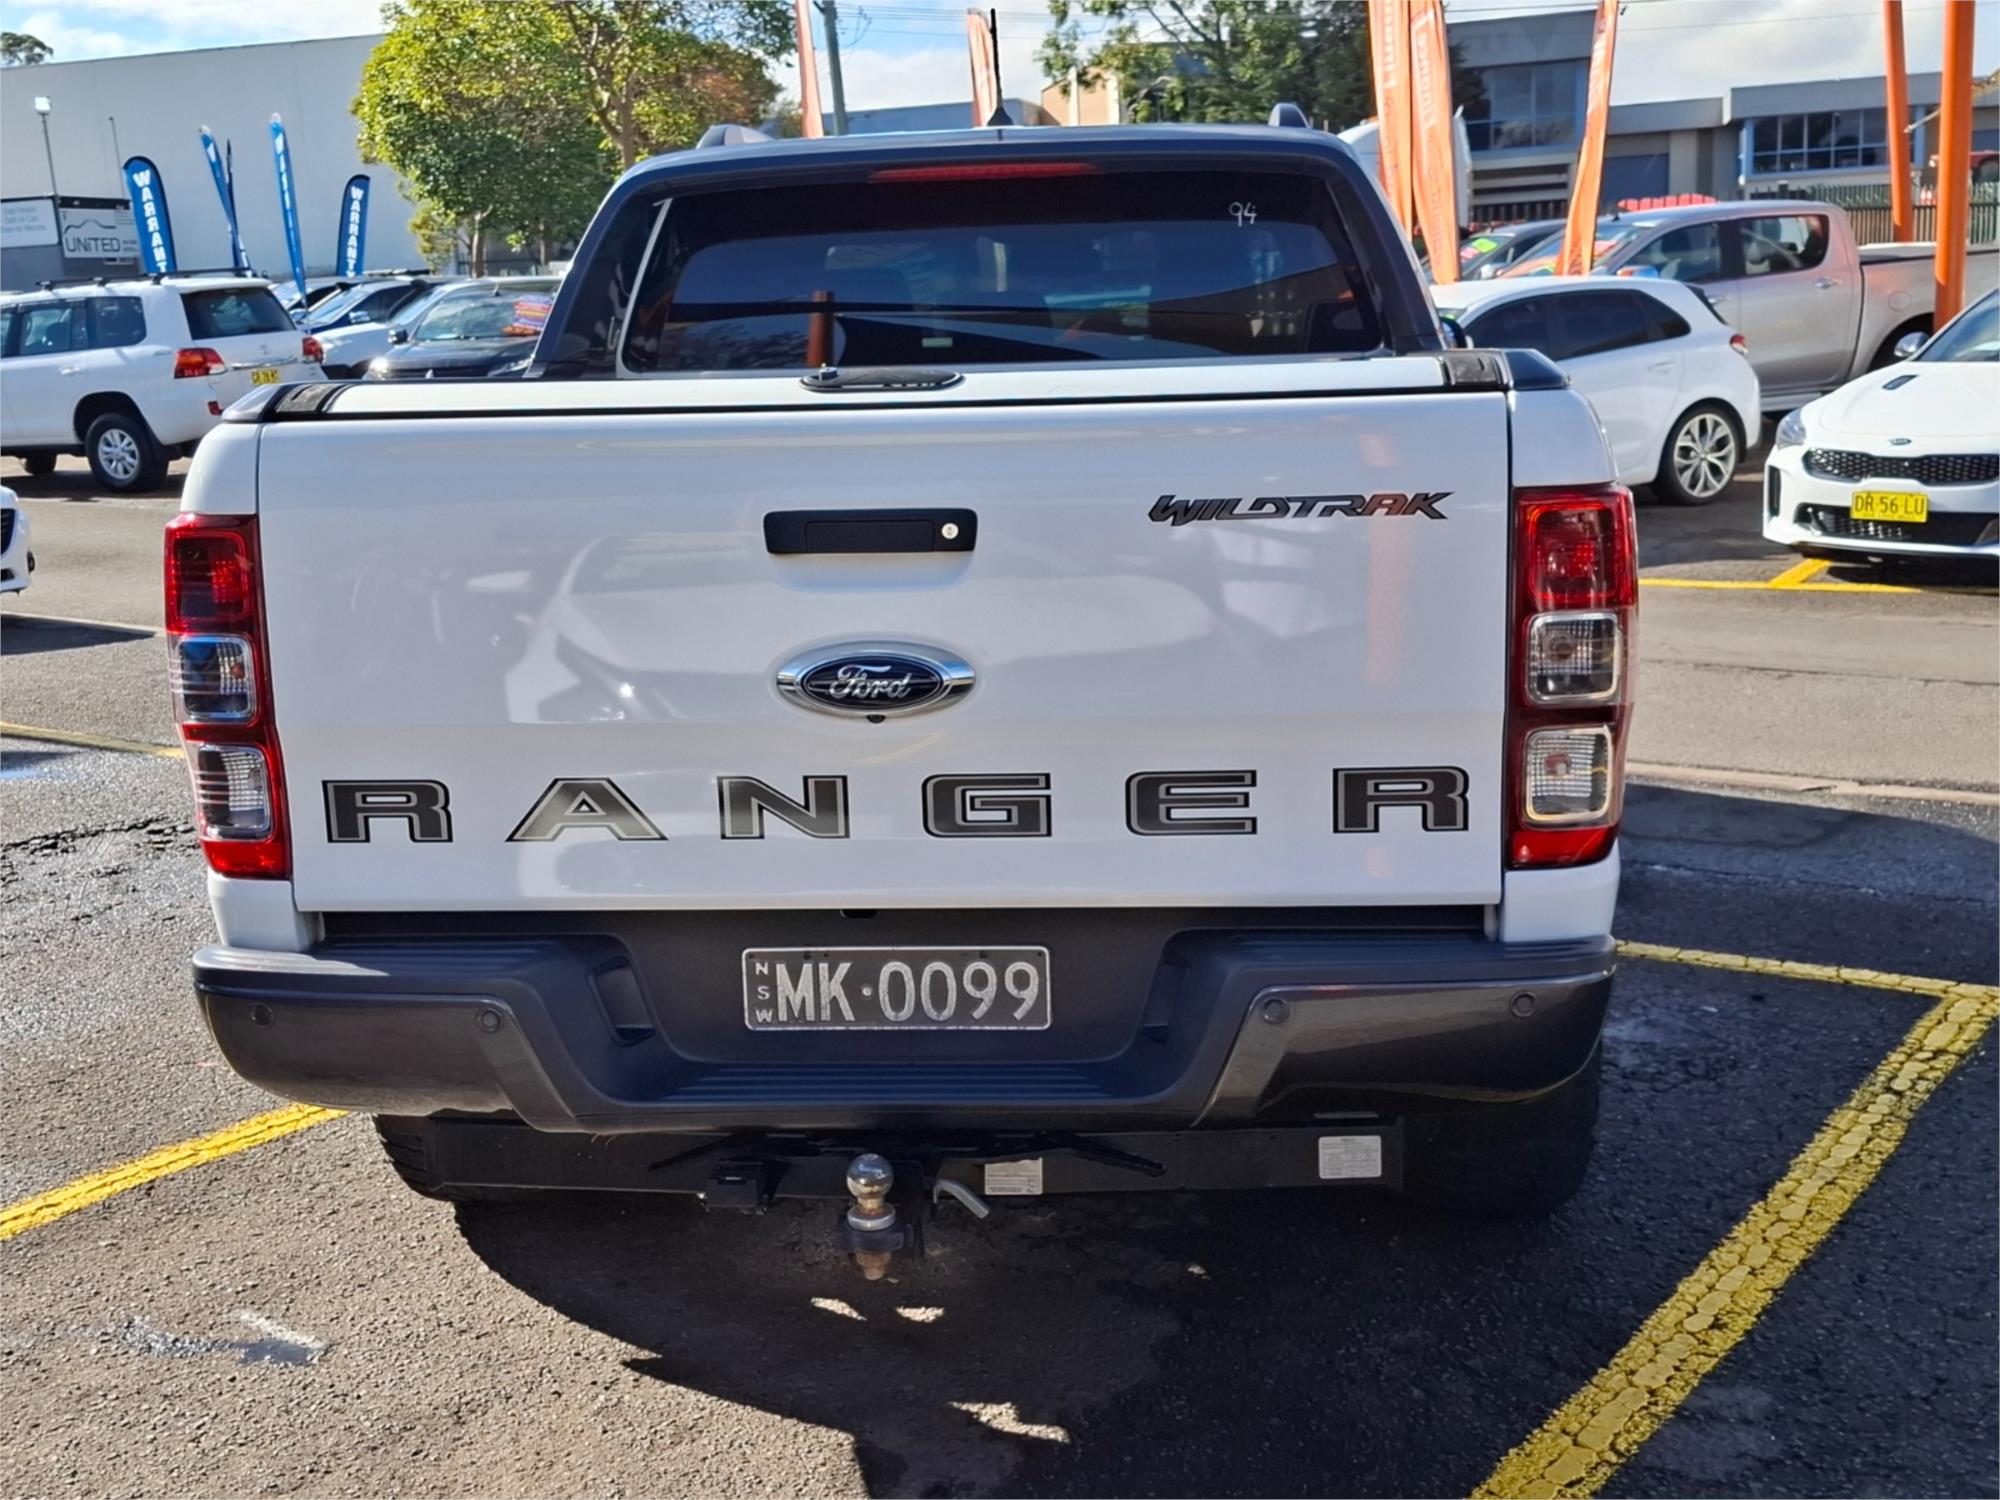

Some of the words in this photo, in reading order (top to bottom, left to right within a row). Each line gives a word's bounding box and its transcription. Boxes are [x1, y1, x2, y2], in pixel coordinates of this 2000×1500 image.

[1228, 201, 1258, 228] 94
[1148, 491, 1455, 527] WILDTRAK
[1855, 494, 1874, 513] DR
[1880, 496, 1899, 514] 56
[1904, 495, 1925, 515] LU
[828, 664, 912, 699] Ford
[322, 766, 1471, 843] RANGER
